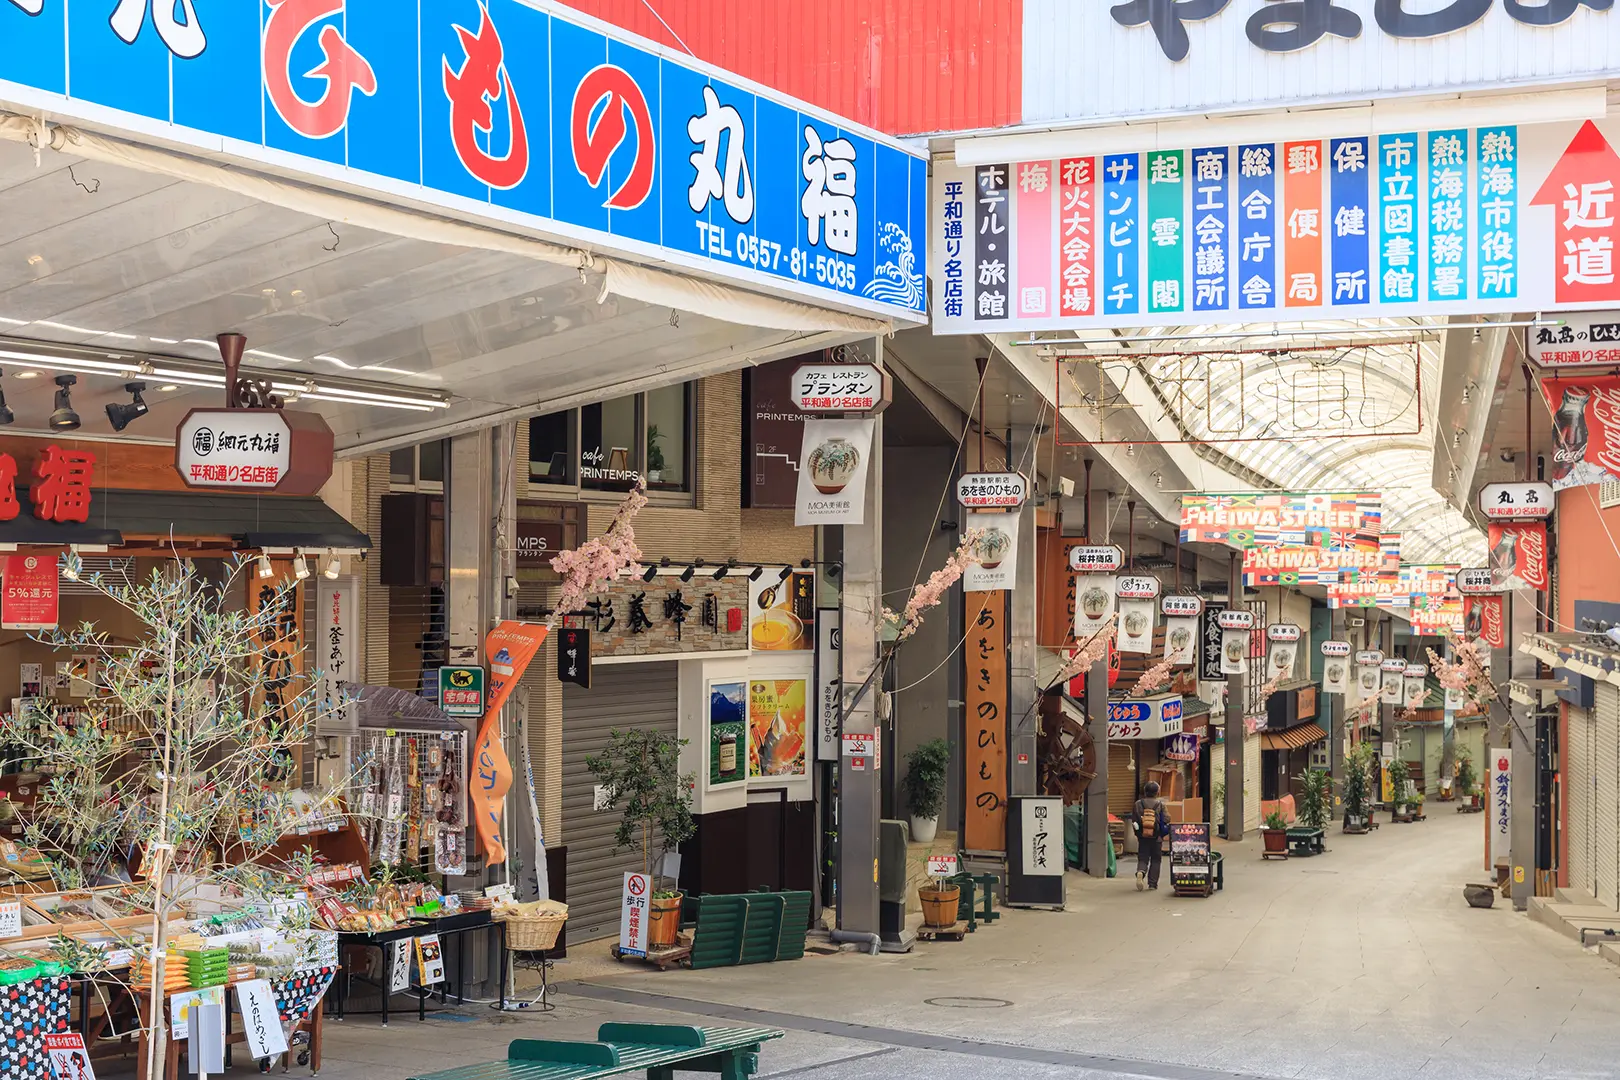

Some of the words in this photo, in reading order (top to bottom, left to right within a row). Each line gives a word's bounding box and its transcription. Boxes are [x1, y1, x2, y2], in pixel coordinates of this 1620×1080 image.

[687, 84, 858, 257] 丸福
[1107, 158, 1134, 310] サンビーチ
[1150, 155, 1181, 309] 起雲閣
[1195, 151, 1226, 307] 商工会議所
[1240, 147, 1272, 305] 総合庁舎
[1287, 145, 1319, 301] 郵便局
[1333, 142, 1367, 301] 保健所
[1382, 138, 1415, 299] 市立図書館
[1431, 134, 1464, 296] 熱海税務署
[1480, 130, 1514, 294] 熱海市役所
[1562, 180, 1615, 286] 近道
[696, 220, 733, 258] TEL
[943, 181, 964, 318] 平和通り名店街
[977, 166, 1006, 317] ホテル・旅館
[1020, 164, 1048, 314] 梅園
[1062, 161, 1091, 312] 花火大会会場
[801, 381, 873, 396] プランタン
[805, 372, 828, 380] カフェ
[832, 371, 869, 379] レストラン
[800, 397, 873, 408] 平和通り名店街
[217, 431, 280, 454] 網元丸福
[189, 464, 279, 483] 平和通り名店街
[960, 484, 1021, 496] あをきのひもの
[963, 496, 1018, 505] 平和通り名店街
[1197, 510, 1278, 528] HEIWA
[1282, 510, 1364, 529] STREET
[1488, 507, 1548, 516] 平和通り名店街
[1078, 554, 1113, 564] 桜井商店
[1253, 549, 1319, 569] HEIWA
[1320, 549, 1387, 569] STREET
[8, 587, 53, 599] 5%還元
[1336, 582, 1391, 595] HEIWA
[1393, 579, 1450, 594] STREET
[329, 627, 345, 675] 釜あげ
[1204, 609, 1221, 677] お食事処
[445, 692, 478, 703] 宅急便
[975, 607, 999, 812] あをきのひもの
[1495, 773, 1511, 834] 鈴廣かまぼこ
[1035, 832, 1048, 868] アオキ
[627, 896, 645, 908] 歩行
[628, 907, 640, 949] 喫煙禁止
